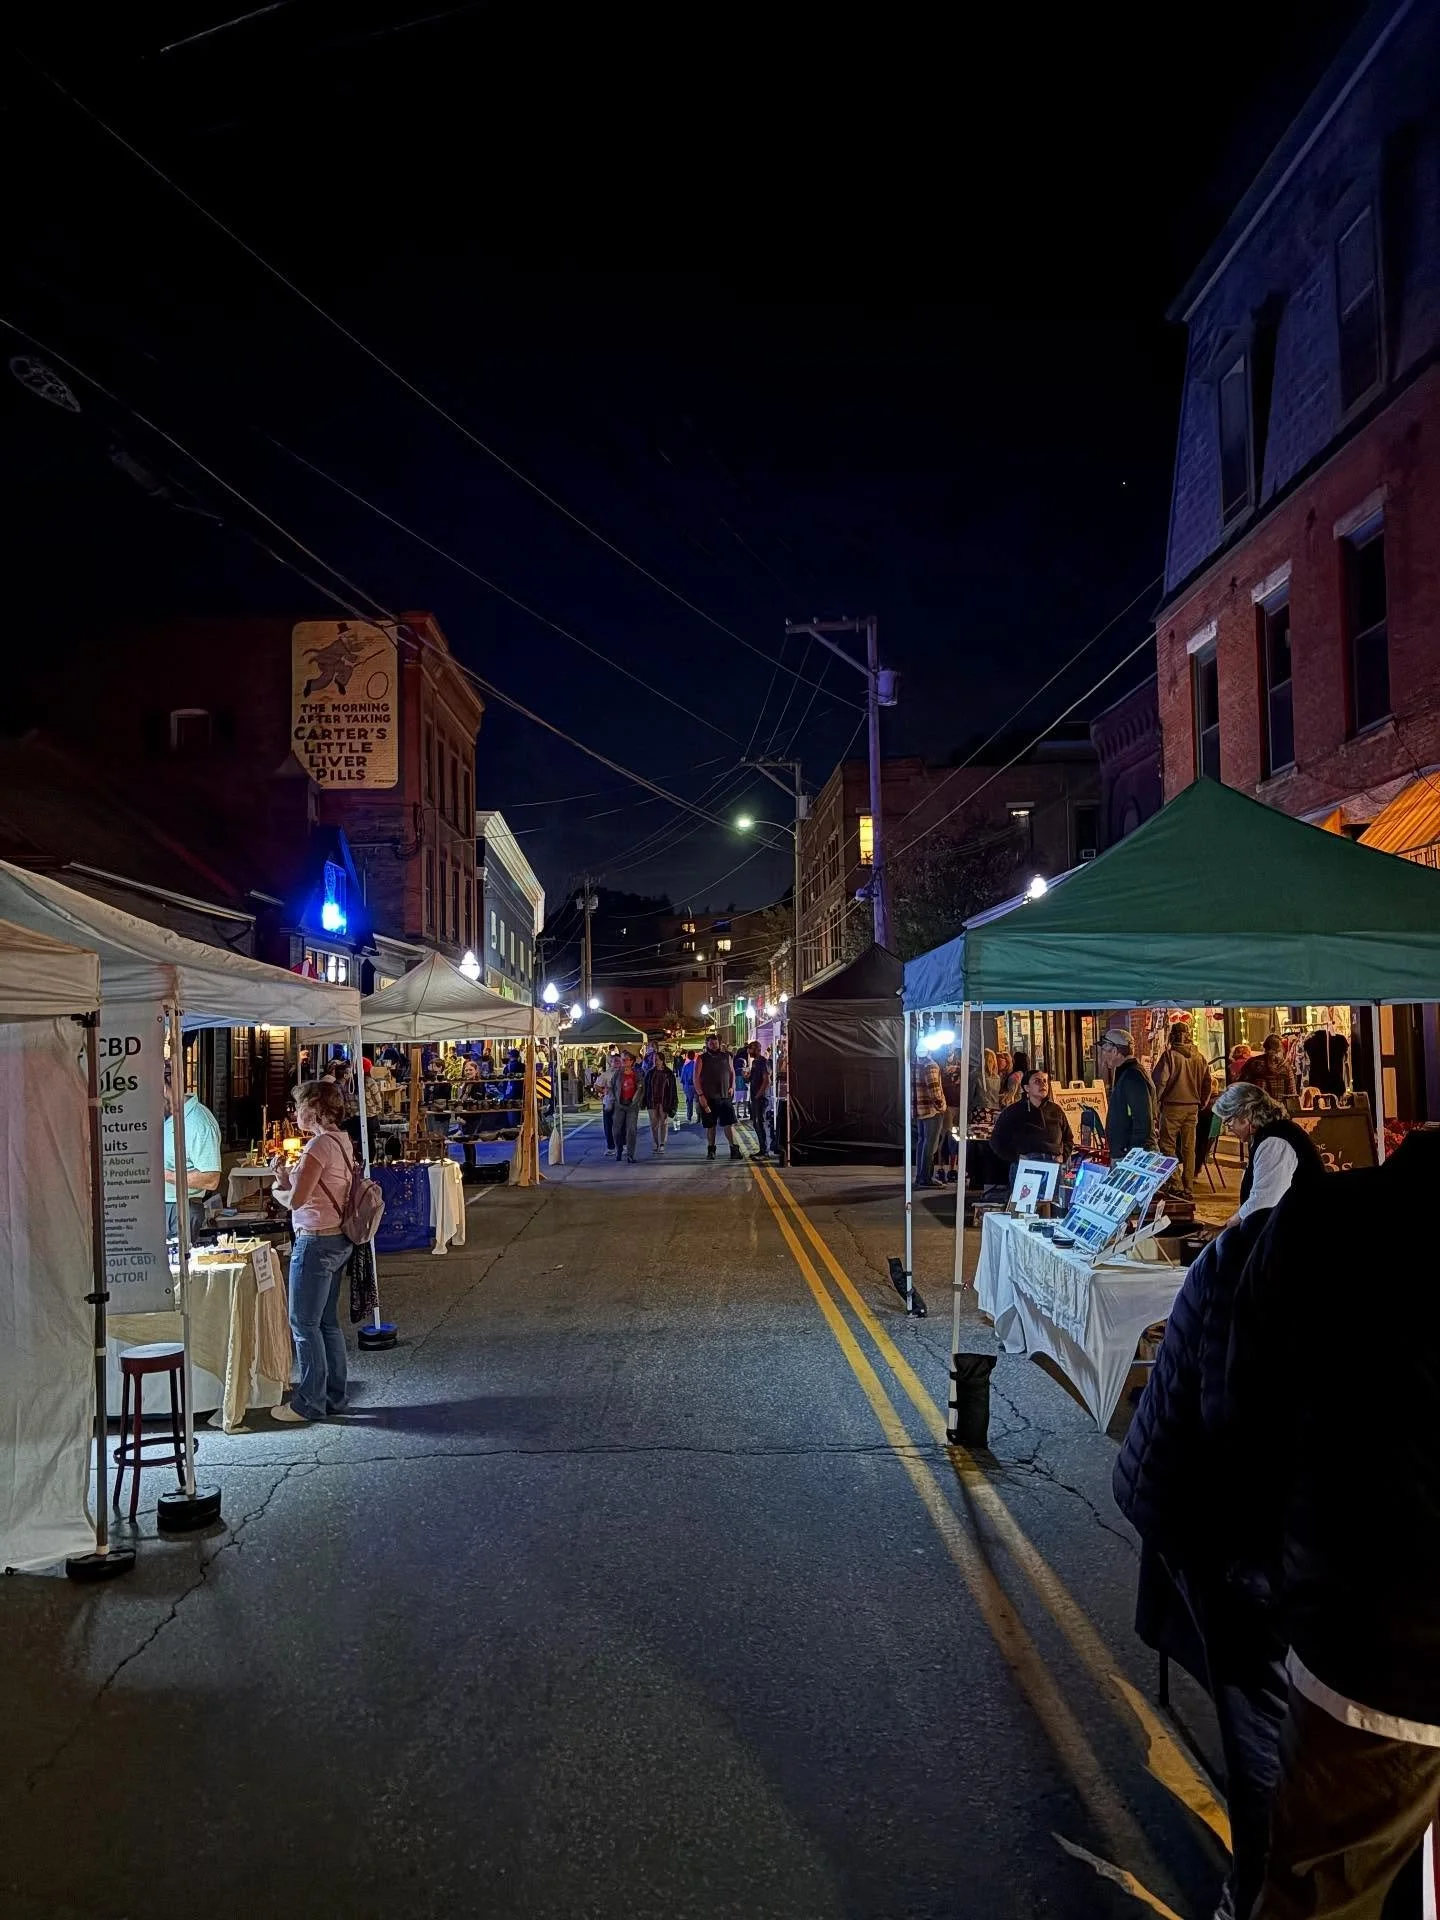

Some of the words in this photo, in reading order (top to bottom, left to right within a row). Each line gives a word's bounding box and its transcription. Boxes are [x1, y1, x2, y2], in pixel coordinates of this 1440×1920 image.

[301, 704, 325, 713] THE
[332, 703, 390, 713] MORNING
[298, 714, 341, 724] AFTER
[345, 714, 391, 723] TAKING
[294, 726, 387, 740] CARTER'S
[304, 740, 373, 754] LITTLE
[309, 755, 367, 767] LIVER
[316, 768, 366, 781] PILLS
[109, 1157, 135, 1166] About
[110, 1168, 150, 1178] Products?
